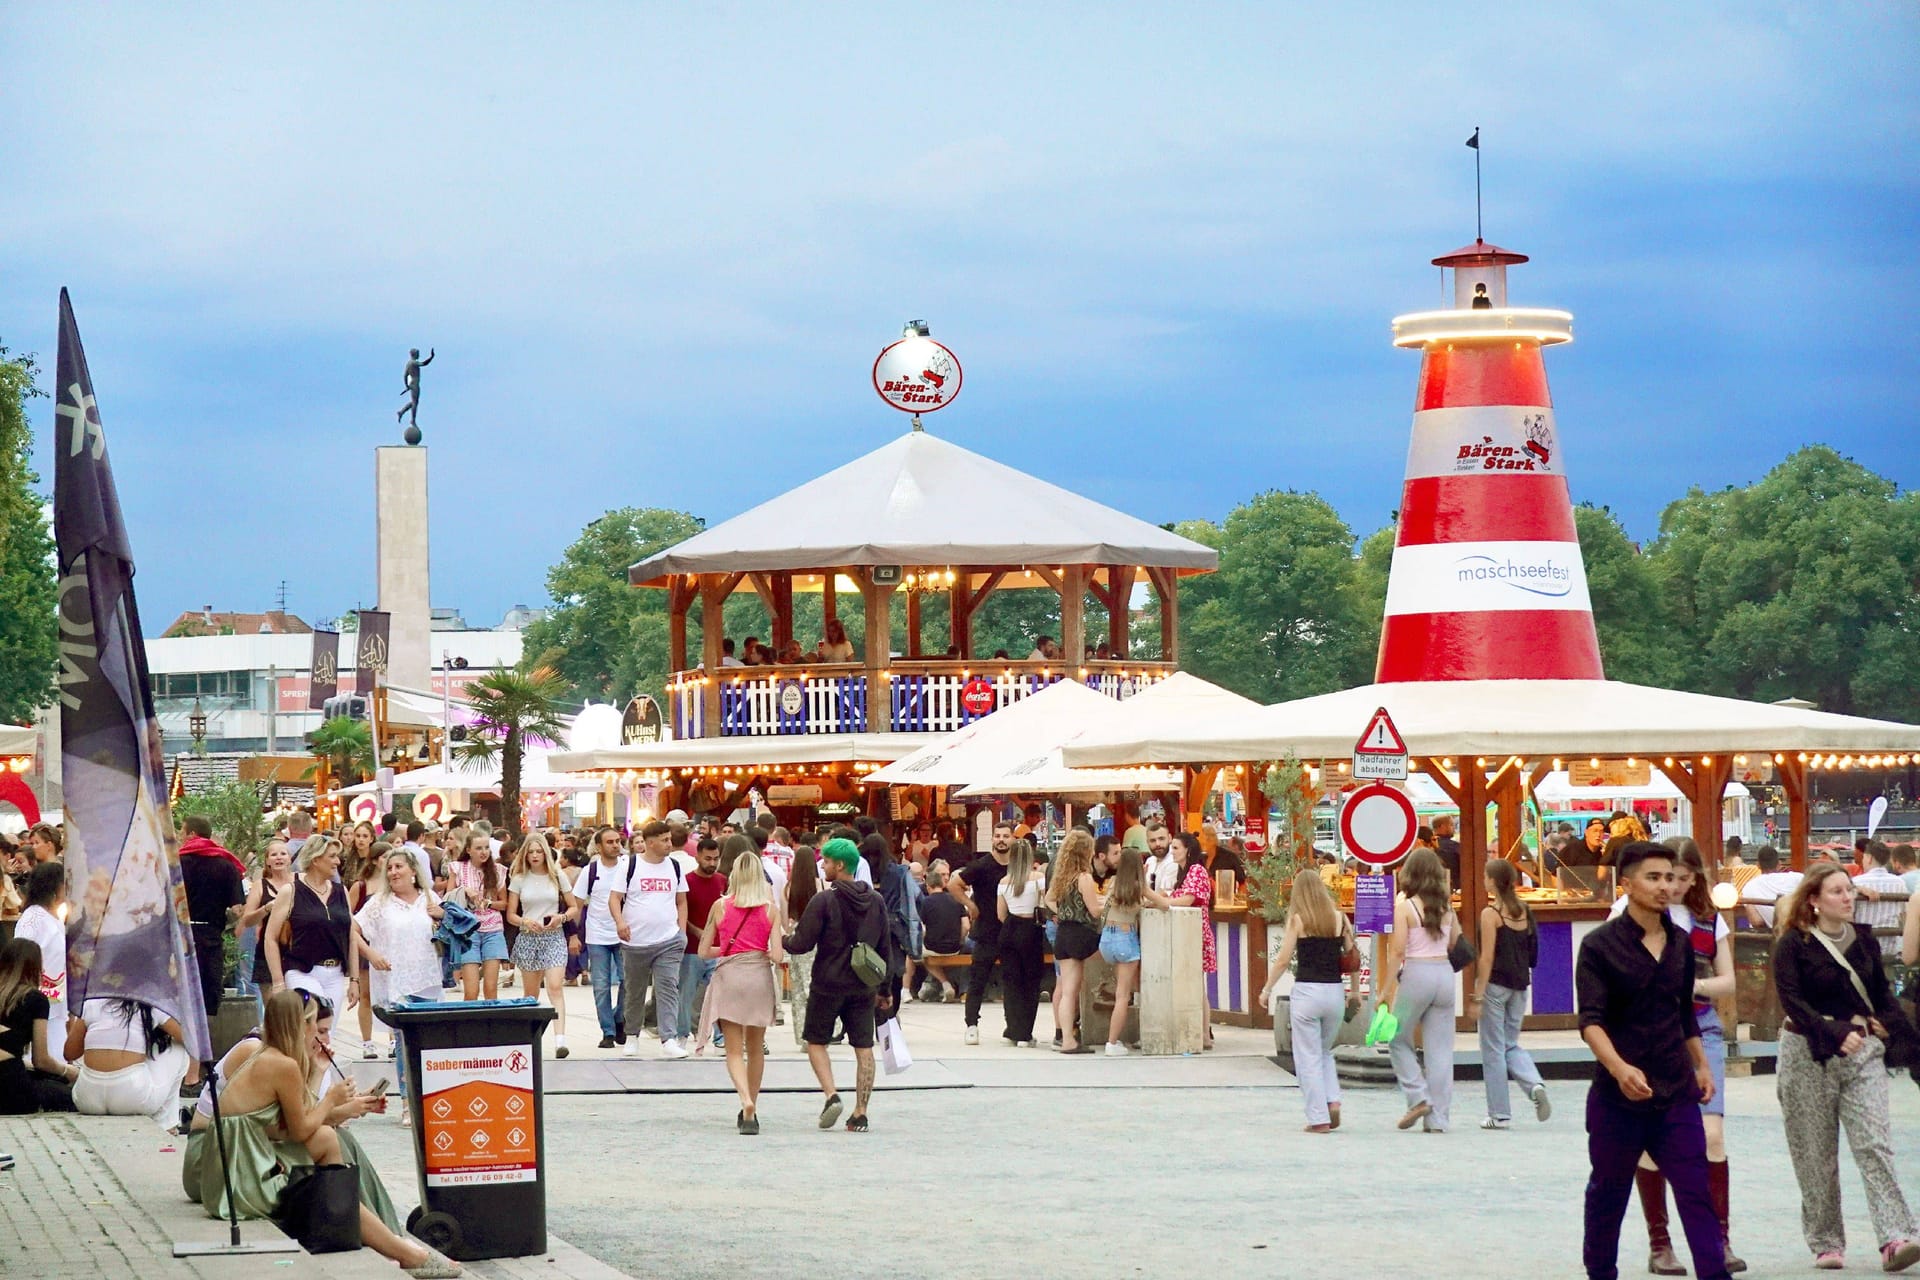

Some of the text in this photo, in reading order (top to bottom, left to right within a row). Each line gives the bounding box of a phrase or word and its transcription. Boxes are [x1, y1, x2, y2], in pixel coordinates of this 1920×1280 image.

[883, 381, 930, 392] Bären-
[902, 392, 942, 403] Stark
[1456, 444, 1520, 459] Bären-
[1483, 457, 1535, 471] Stark
[1458, 560, 1569, 582] maschseefest
[1360, 755, 1401, 765] Radfahrer
[1360, 765, 1401, 775] absteigen
[425, 1058, 503, 1071] Saubermänner
